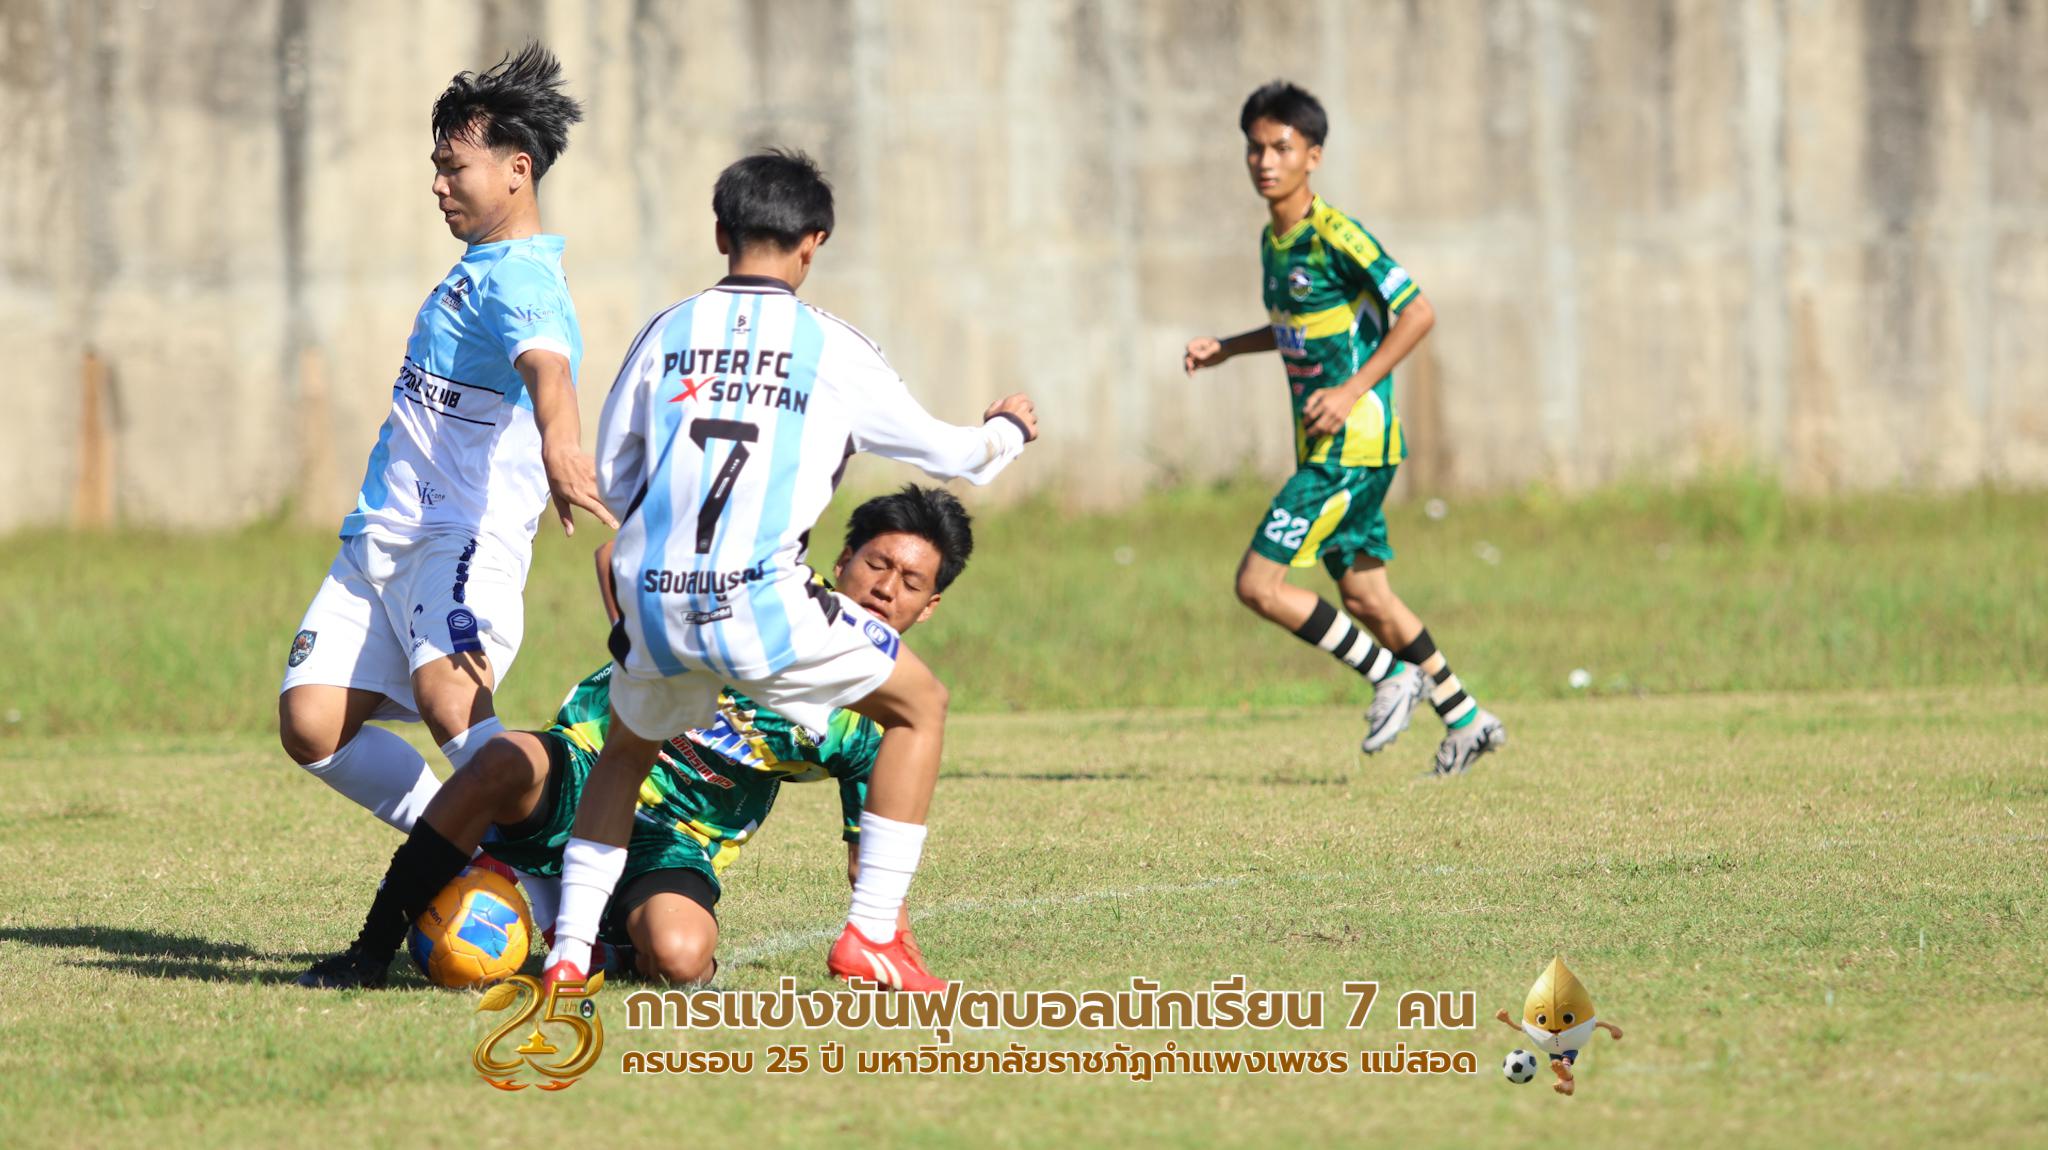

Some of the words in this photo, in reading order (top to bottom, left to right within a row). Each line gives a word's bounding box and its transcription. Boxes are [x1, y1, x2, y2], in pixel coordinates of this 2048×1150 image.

[663, 348, 750, 378] PUTER
[756, 350, 793, 379] FC
[709, 381, 809, 414] SOYTAN
[689, 417, 760, 554] 7
[1264, 508, 1310, 550] 22
